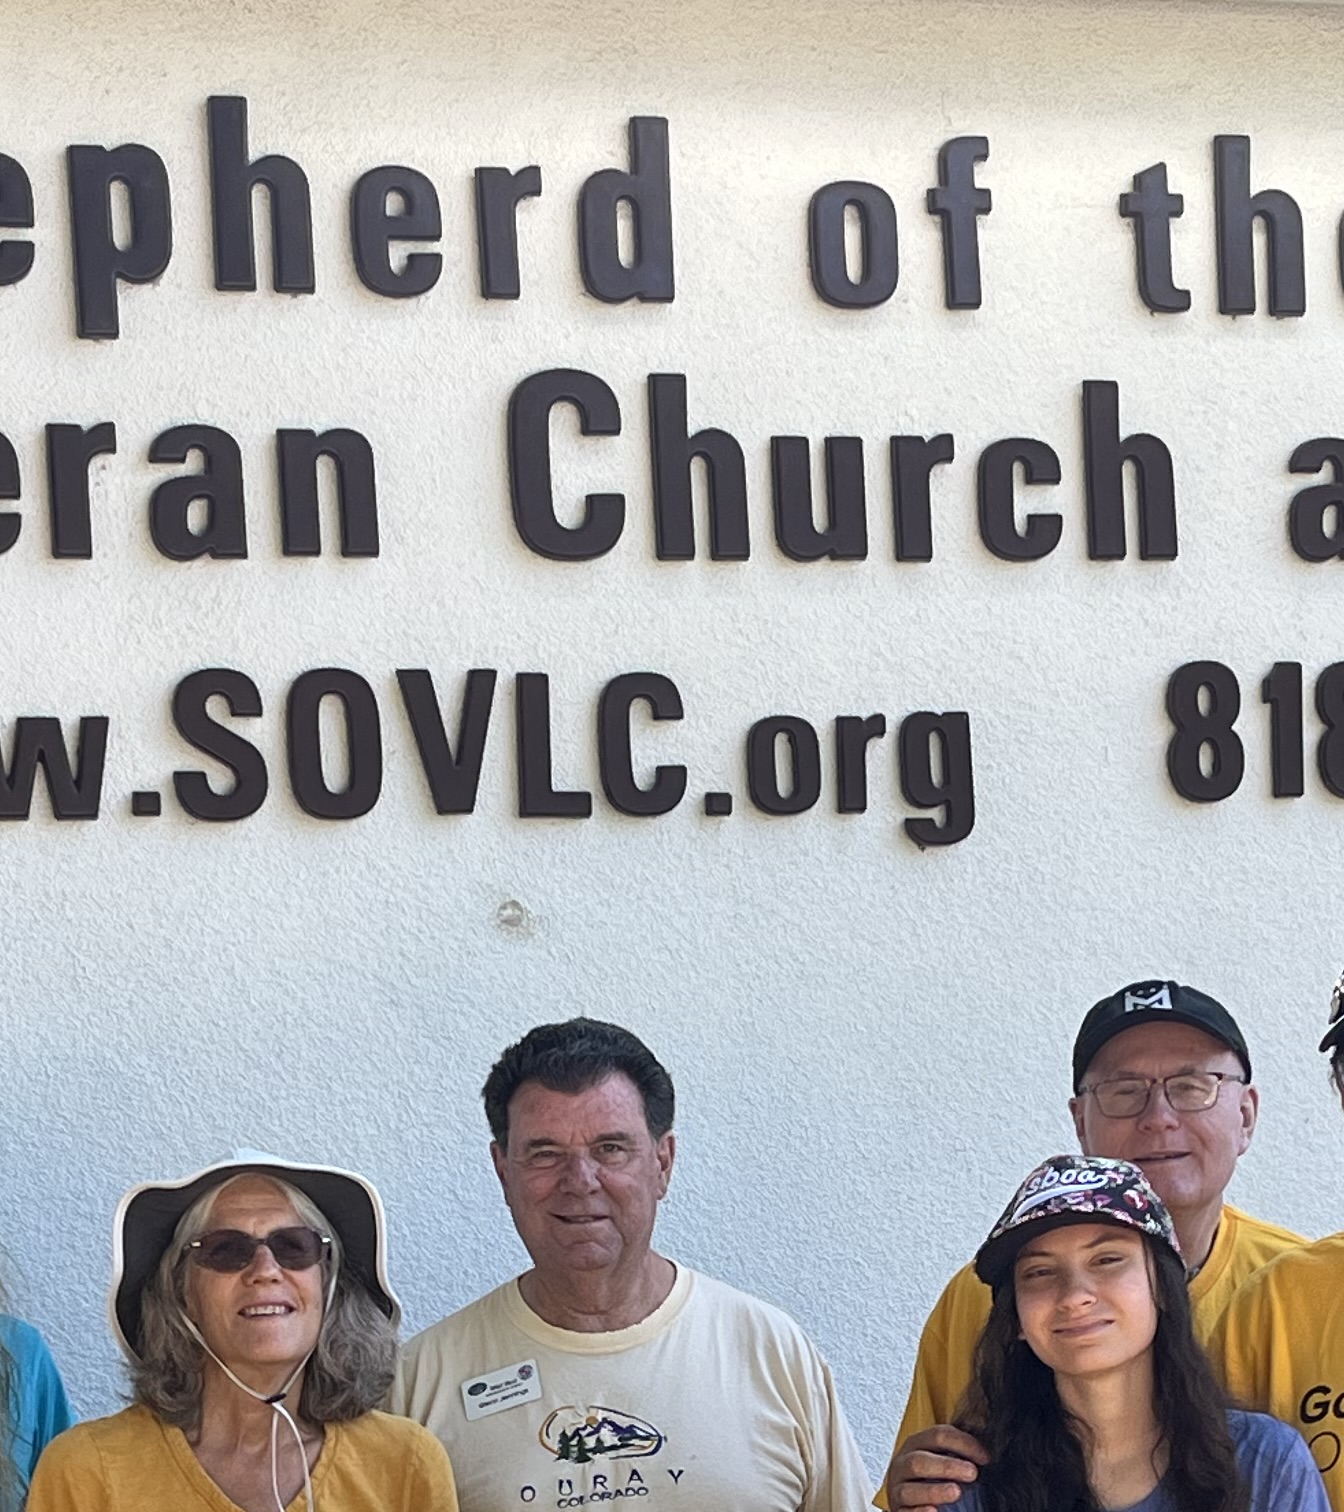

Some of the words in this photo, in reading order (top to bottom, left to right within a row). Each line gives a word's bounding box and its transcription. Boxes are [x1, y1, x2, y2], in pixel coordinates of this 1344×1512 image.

[808, 137, 991, 309] of
[507, 369, 1177, 562] Church
[557, 1486, 649, 1509] COLORADO
